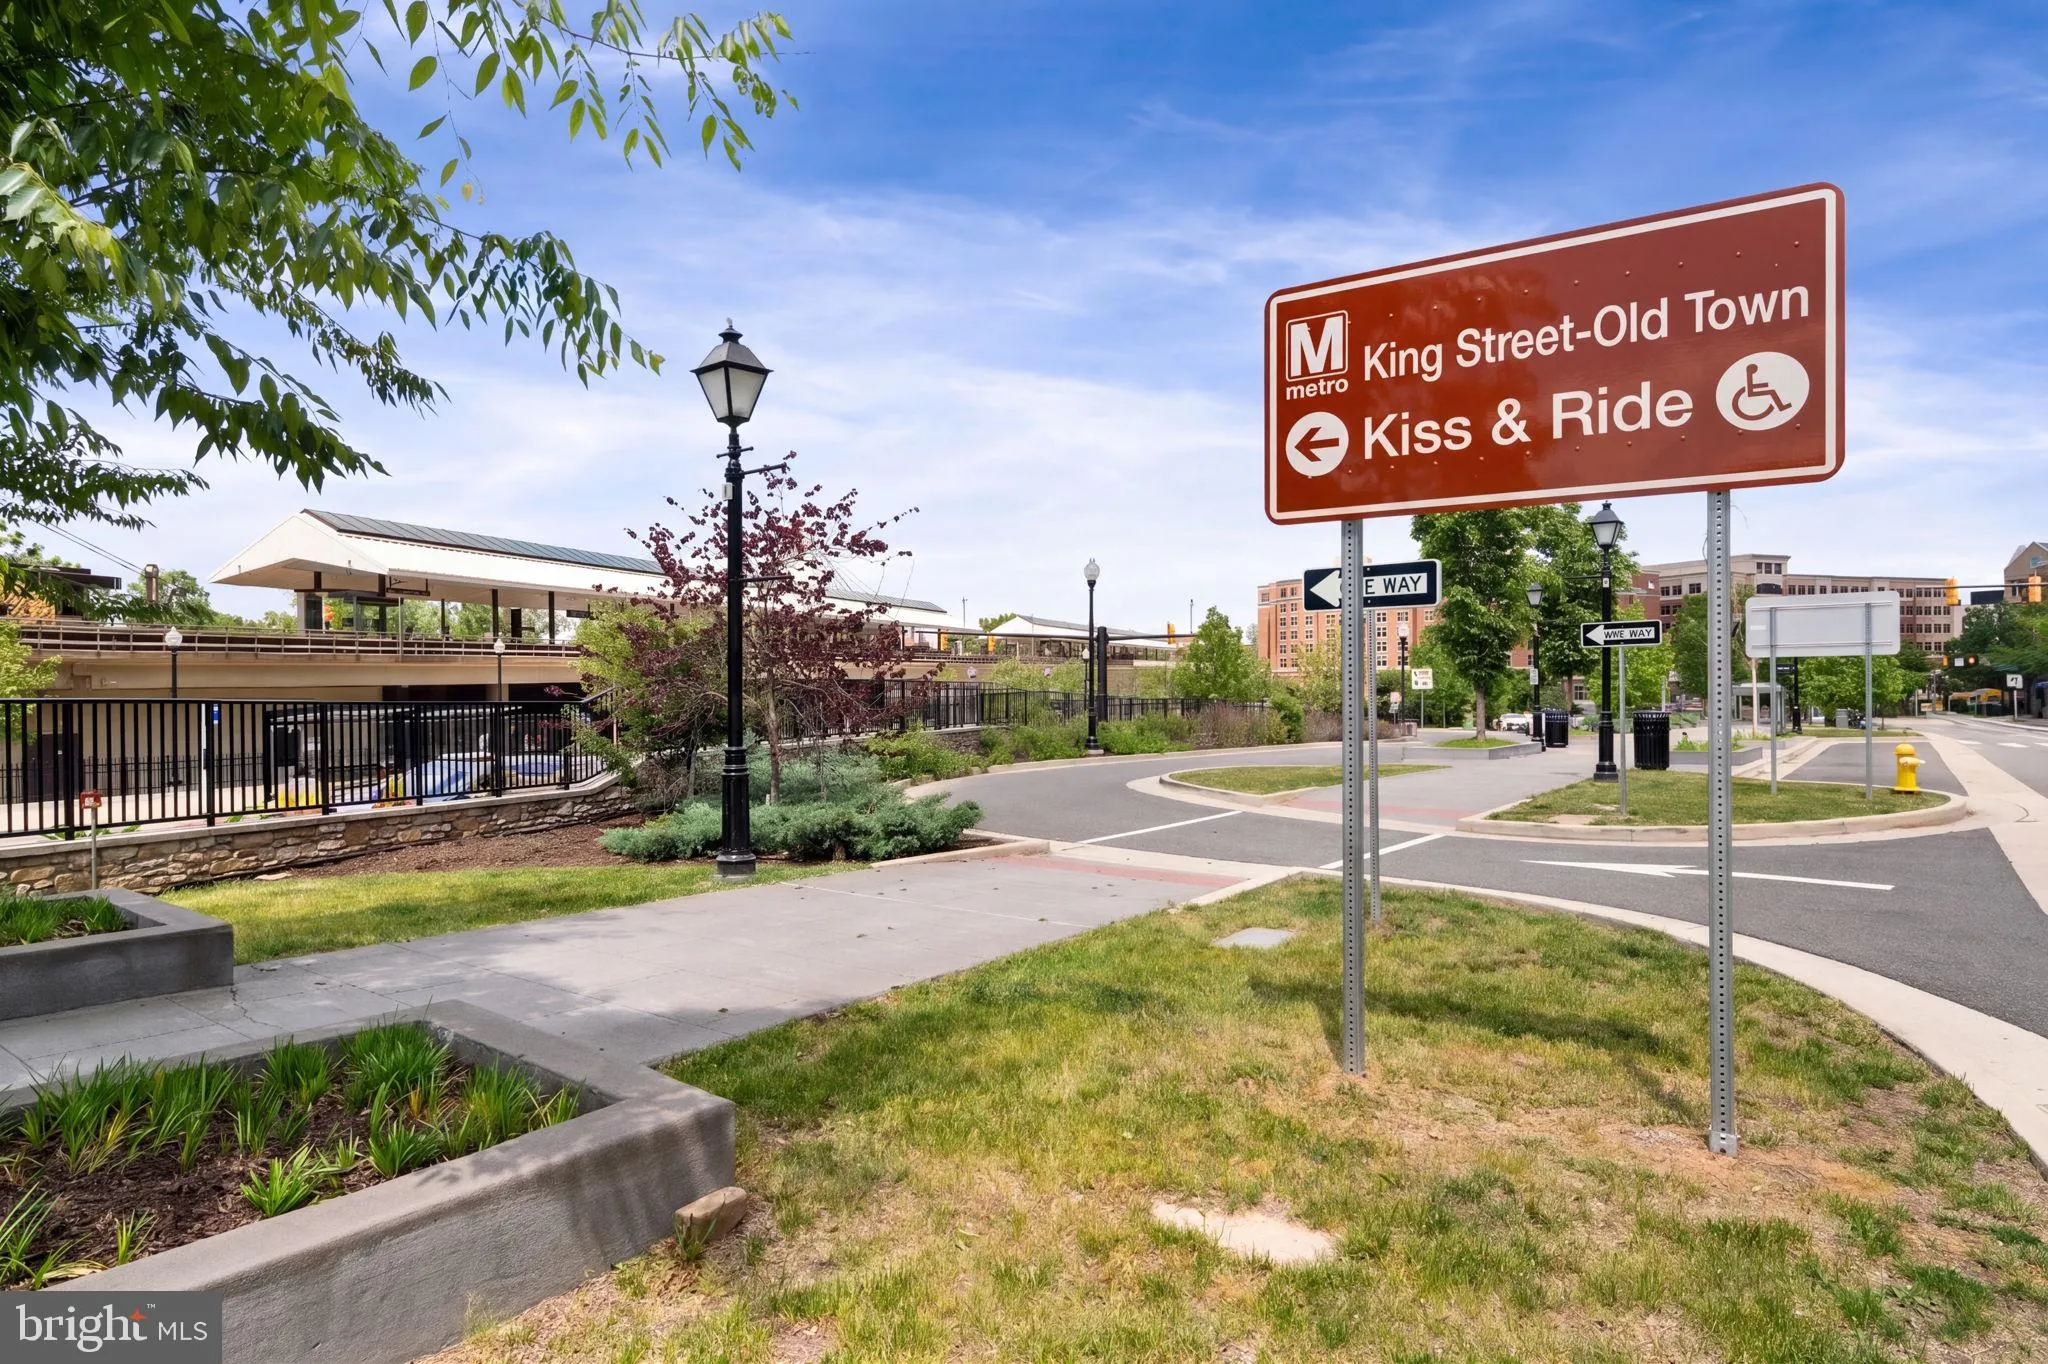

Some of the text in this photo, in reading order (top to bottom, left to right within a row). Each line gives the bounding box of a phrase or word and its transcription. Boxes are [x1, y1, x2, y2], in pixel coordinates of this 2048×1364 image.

[1290, 315, 1344, 378] M
[1364, 285, 1809, 382] King Street-Old Town
[1285, 378, 1349, 400] metro
[1364, 380, 1694, 460] Kiss & Ride
[1383, 575, 1421, 594] WAY
[1629, 628, 1652, 638] WAY
